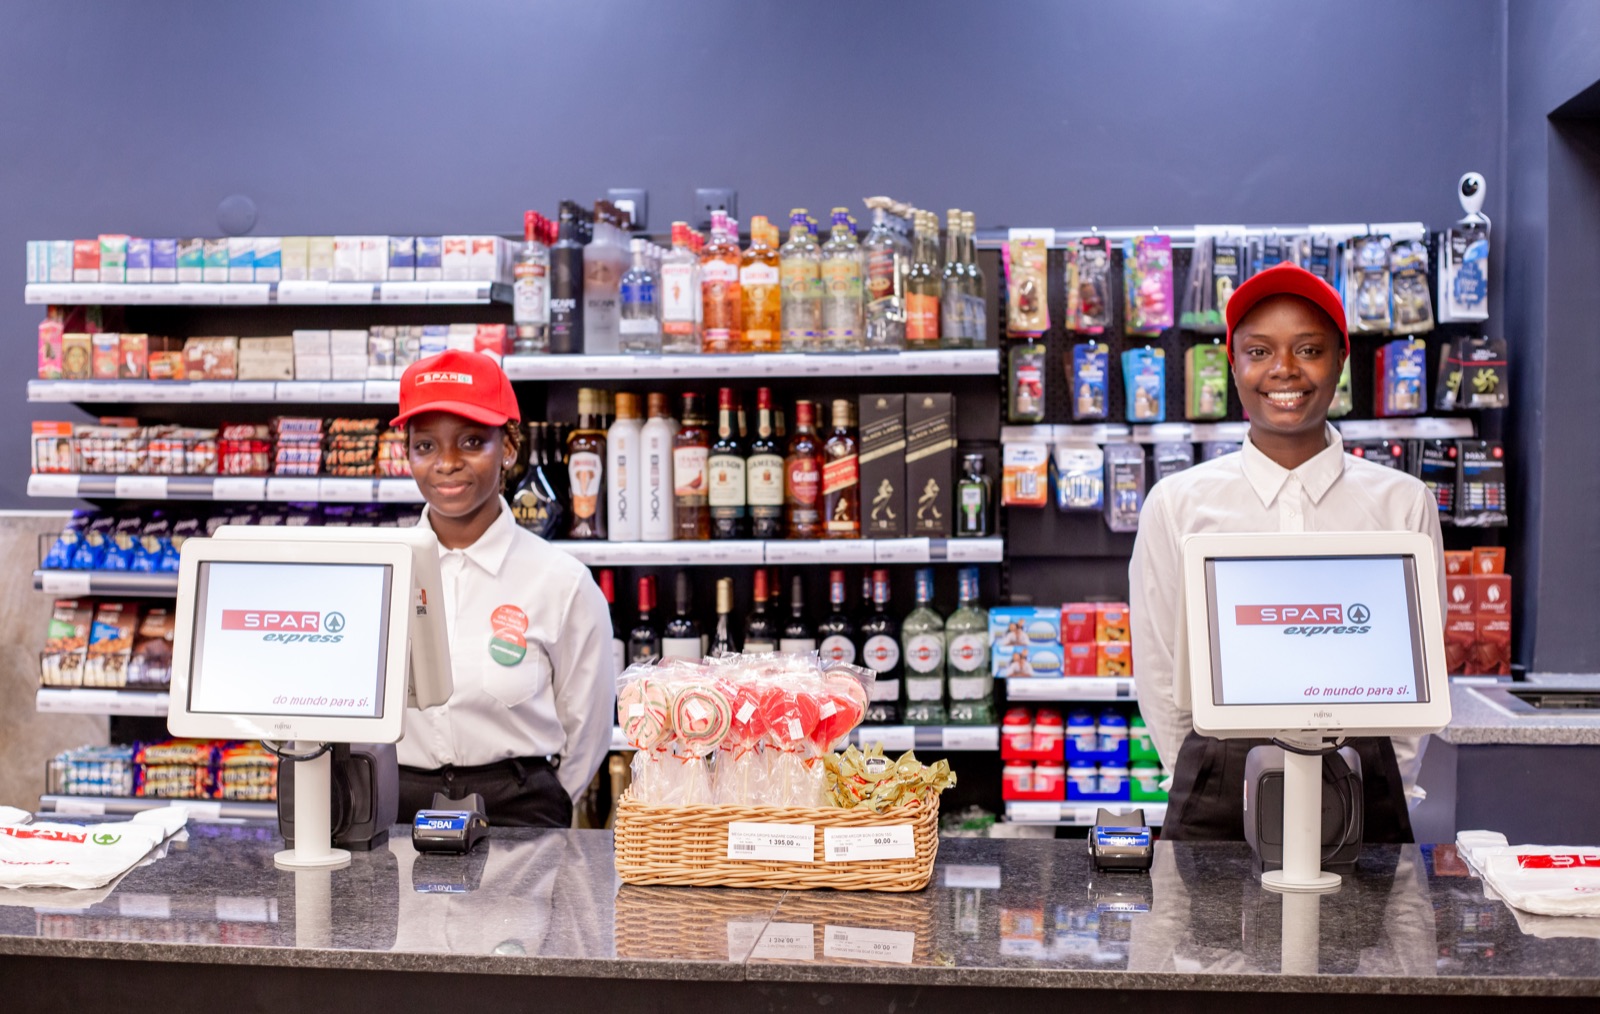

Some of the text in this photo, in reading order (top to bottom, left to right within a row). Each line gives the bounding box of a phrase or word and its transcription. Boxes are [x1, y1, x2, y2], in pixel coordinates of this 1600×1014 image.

[423, 373, 458, 381] SPAR
[512, 506, 549, 519] KIRA
[1260, 607, 1341, 621] SPAR
[244, 613, 318, 628] SPAR
[1283, 625, 1372, 637] express
[262, 632, 344, 644] express
[1303, 686, 1320, 696] do
[1323, 686, 1364, 696] mundo
[1367, 686, 1394, 697] para
[272, 694, 288, 705] do
[289, 695, 328, 706] mundo
[329, 697, 355, 708] para
[437, 821, 452, 829] BAI
